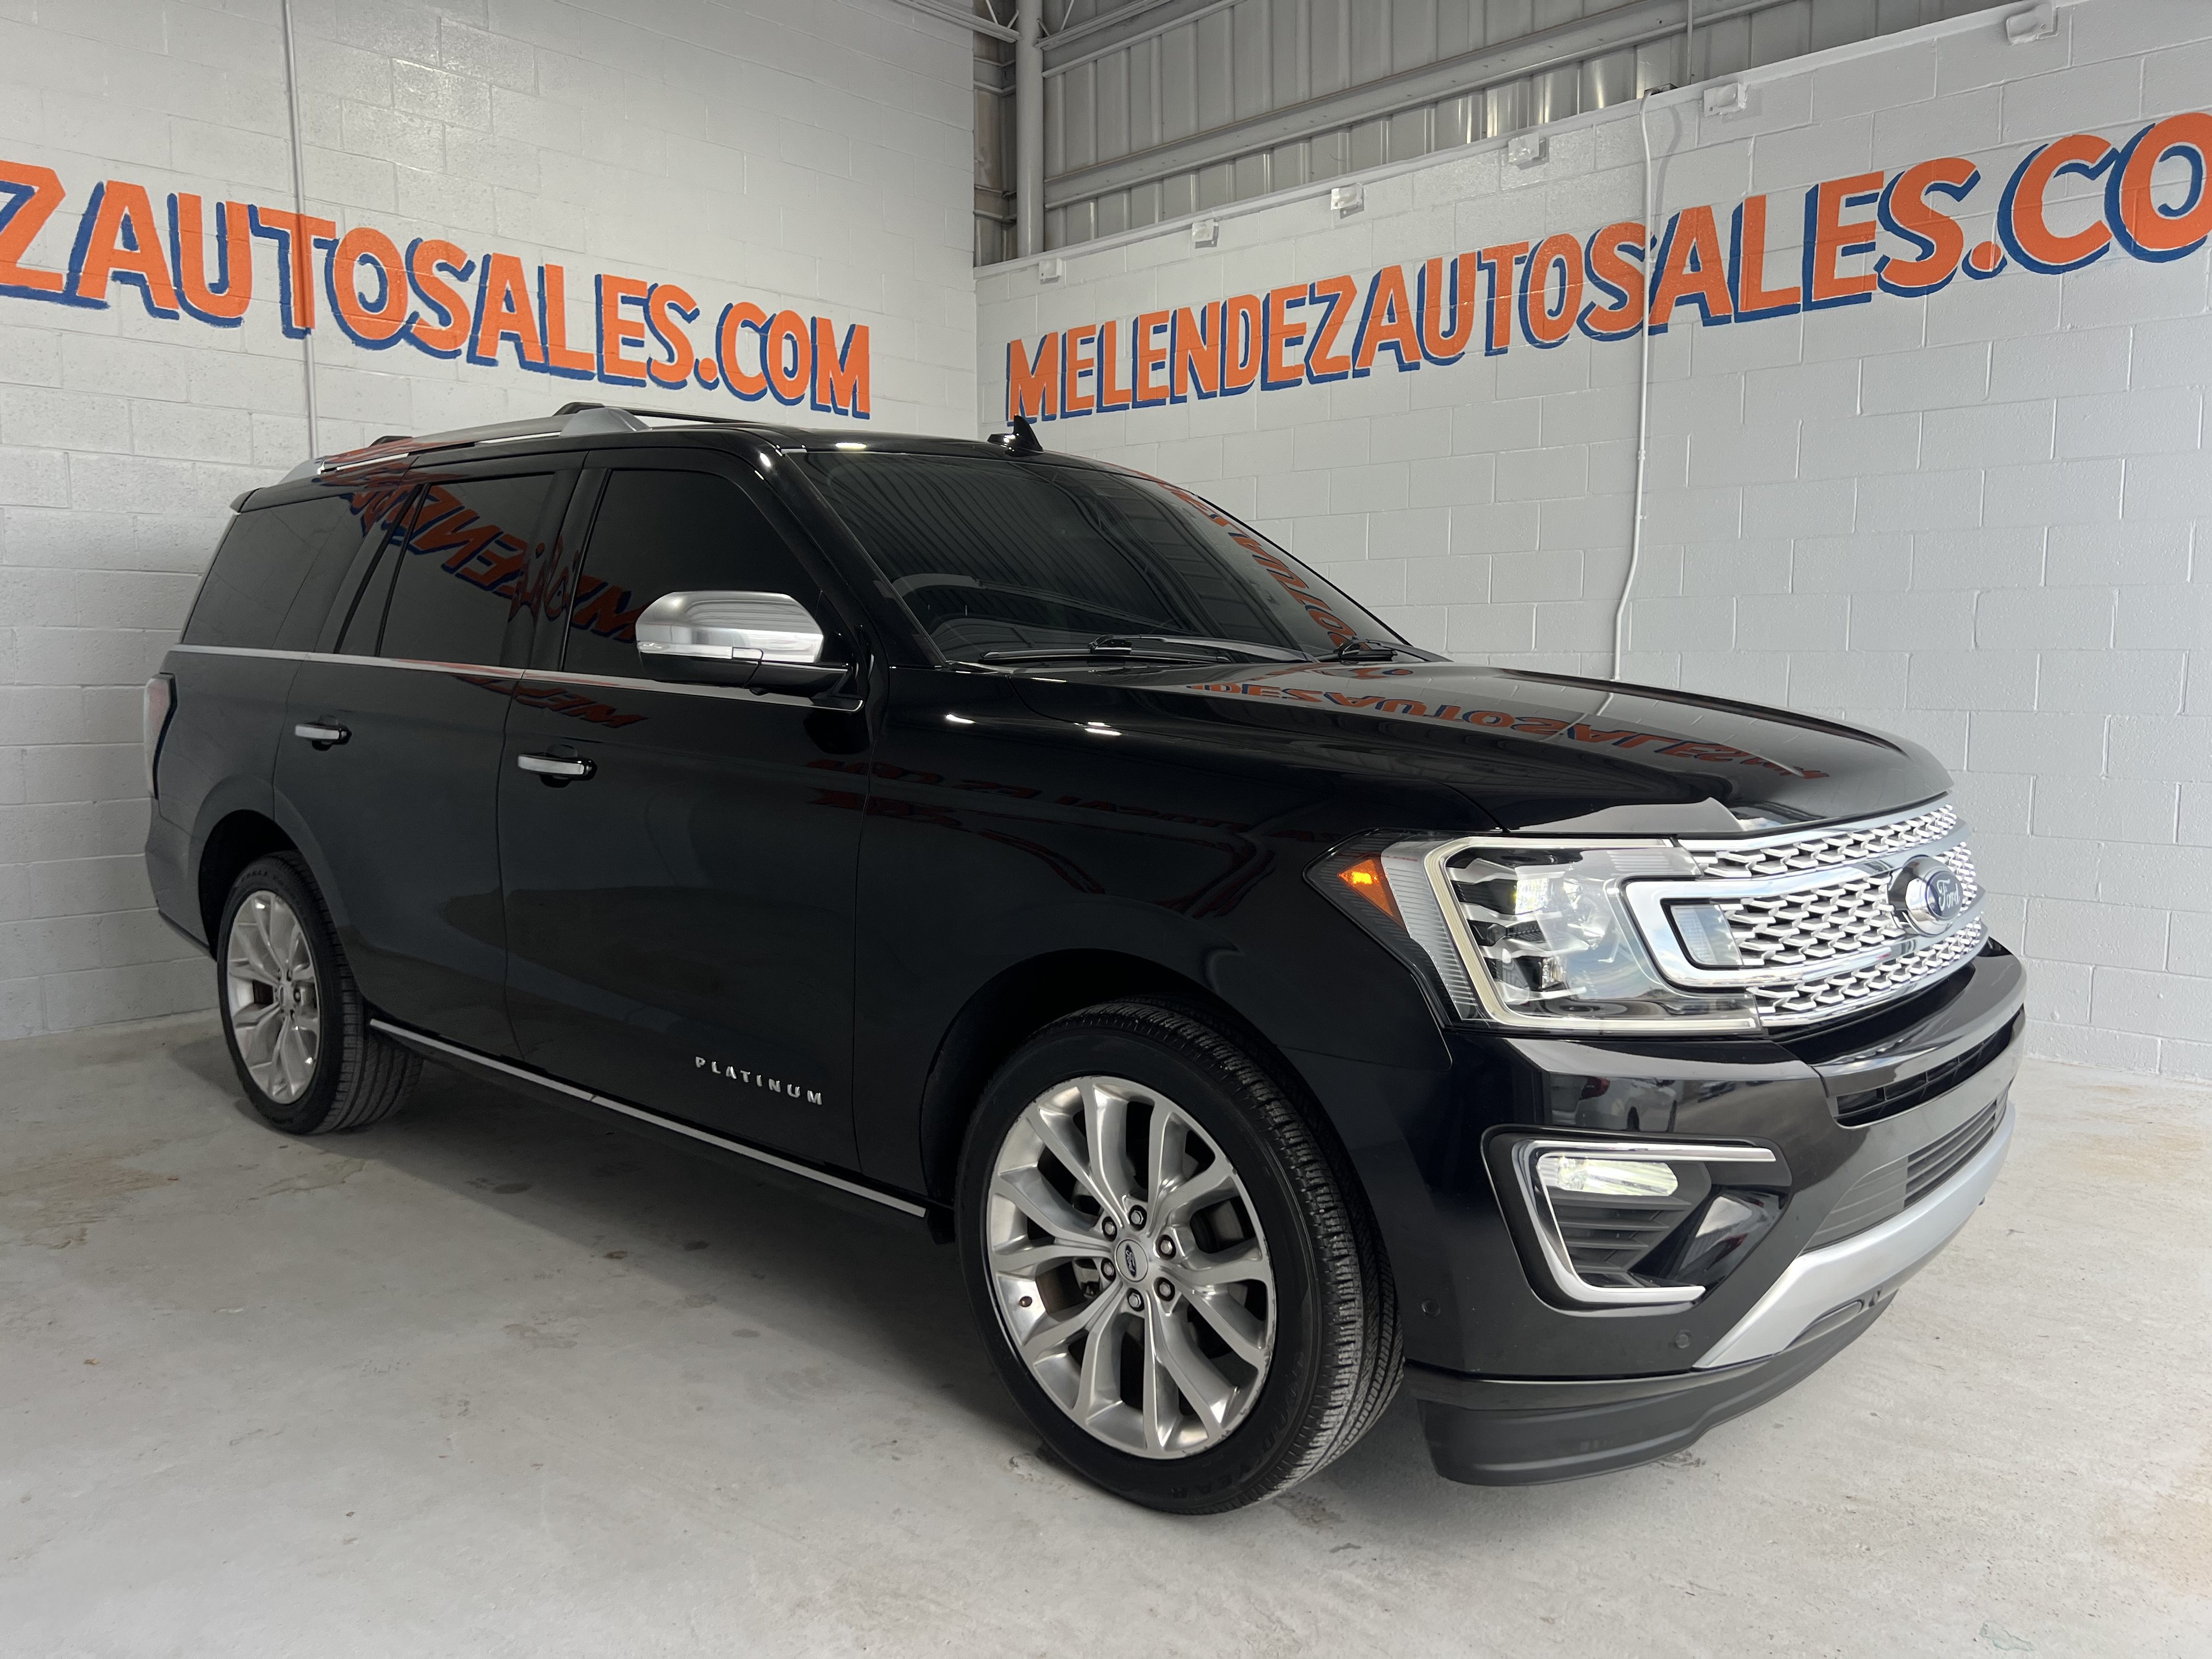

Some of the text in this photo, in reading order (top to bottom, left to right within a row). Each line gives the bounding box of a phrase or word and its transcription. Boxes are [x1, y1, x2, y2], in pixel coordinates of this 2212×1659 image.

[1006, 112, 2212, 427] MELENDEZAUTOSALES.CO
[1936, 878, 1960, 912] Ford
[695, 1056, 822, 1105] PLATINUM
